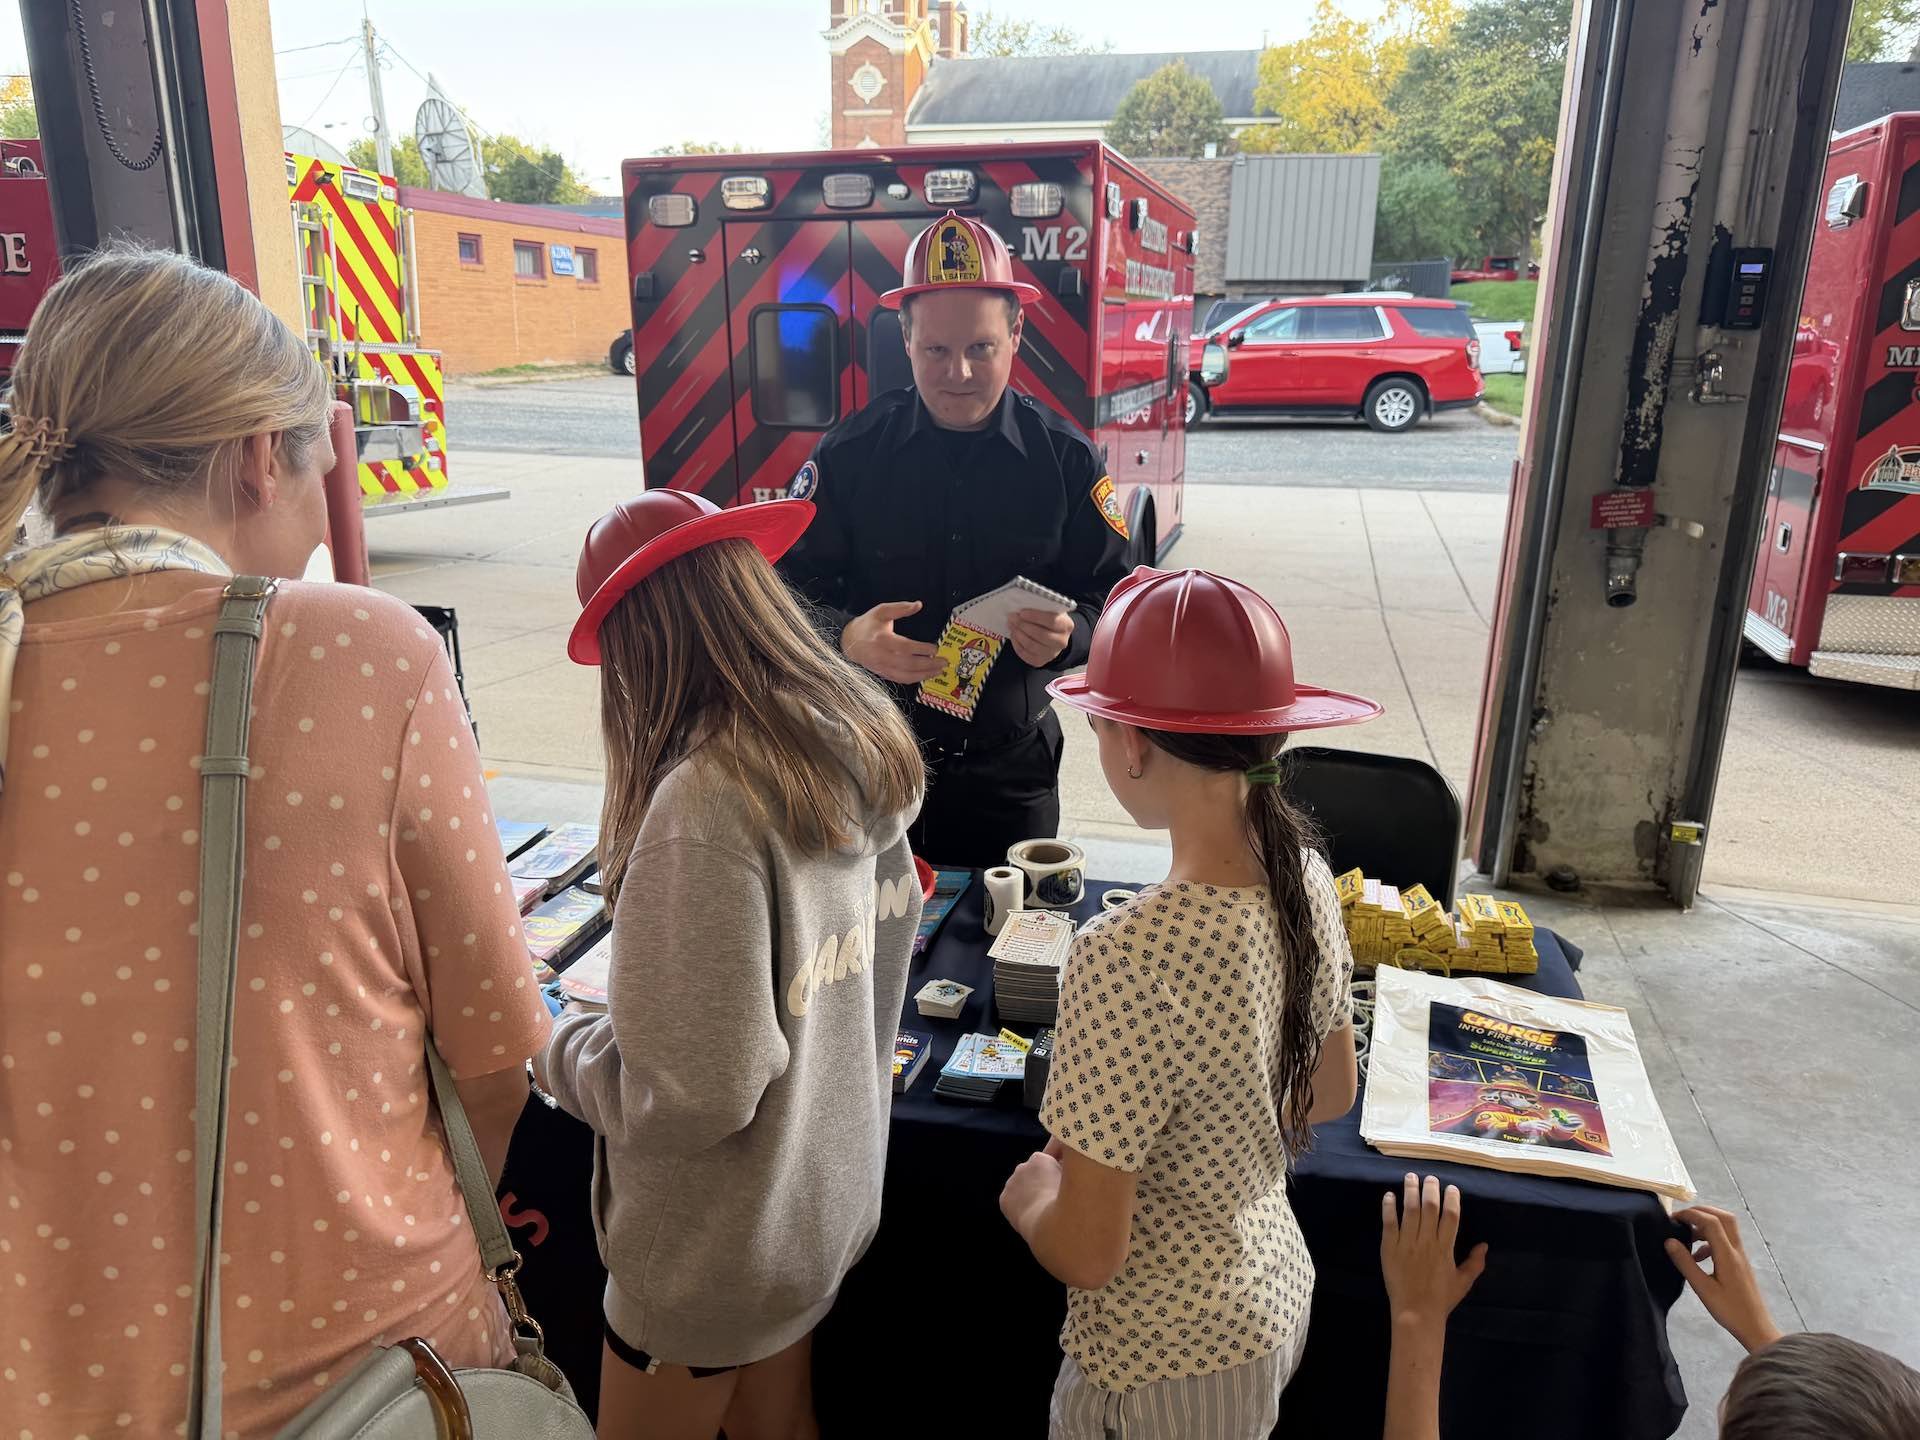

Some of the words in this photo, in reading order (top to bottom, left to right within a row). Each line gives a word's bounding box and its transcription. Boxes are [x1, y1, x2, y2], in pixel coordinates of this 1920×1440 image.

[1021, 225, 1088, 261] M2
[948, 272, 977, 280] SAFETY
[1764, 590, 1789, 630] M3
[920, 692, 946, 708] ANIMAL
[1458, 1022, 1485, 1035] INTO
[1487, 1030, 1512, 1043] FIRE
[1514, 1039, 1558, 1053] SAFETY
[1462, 1011, 1558, 1046] CHARGE
[1470, 1041, 1548, 1064] SUPERPOWER
